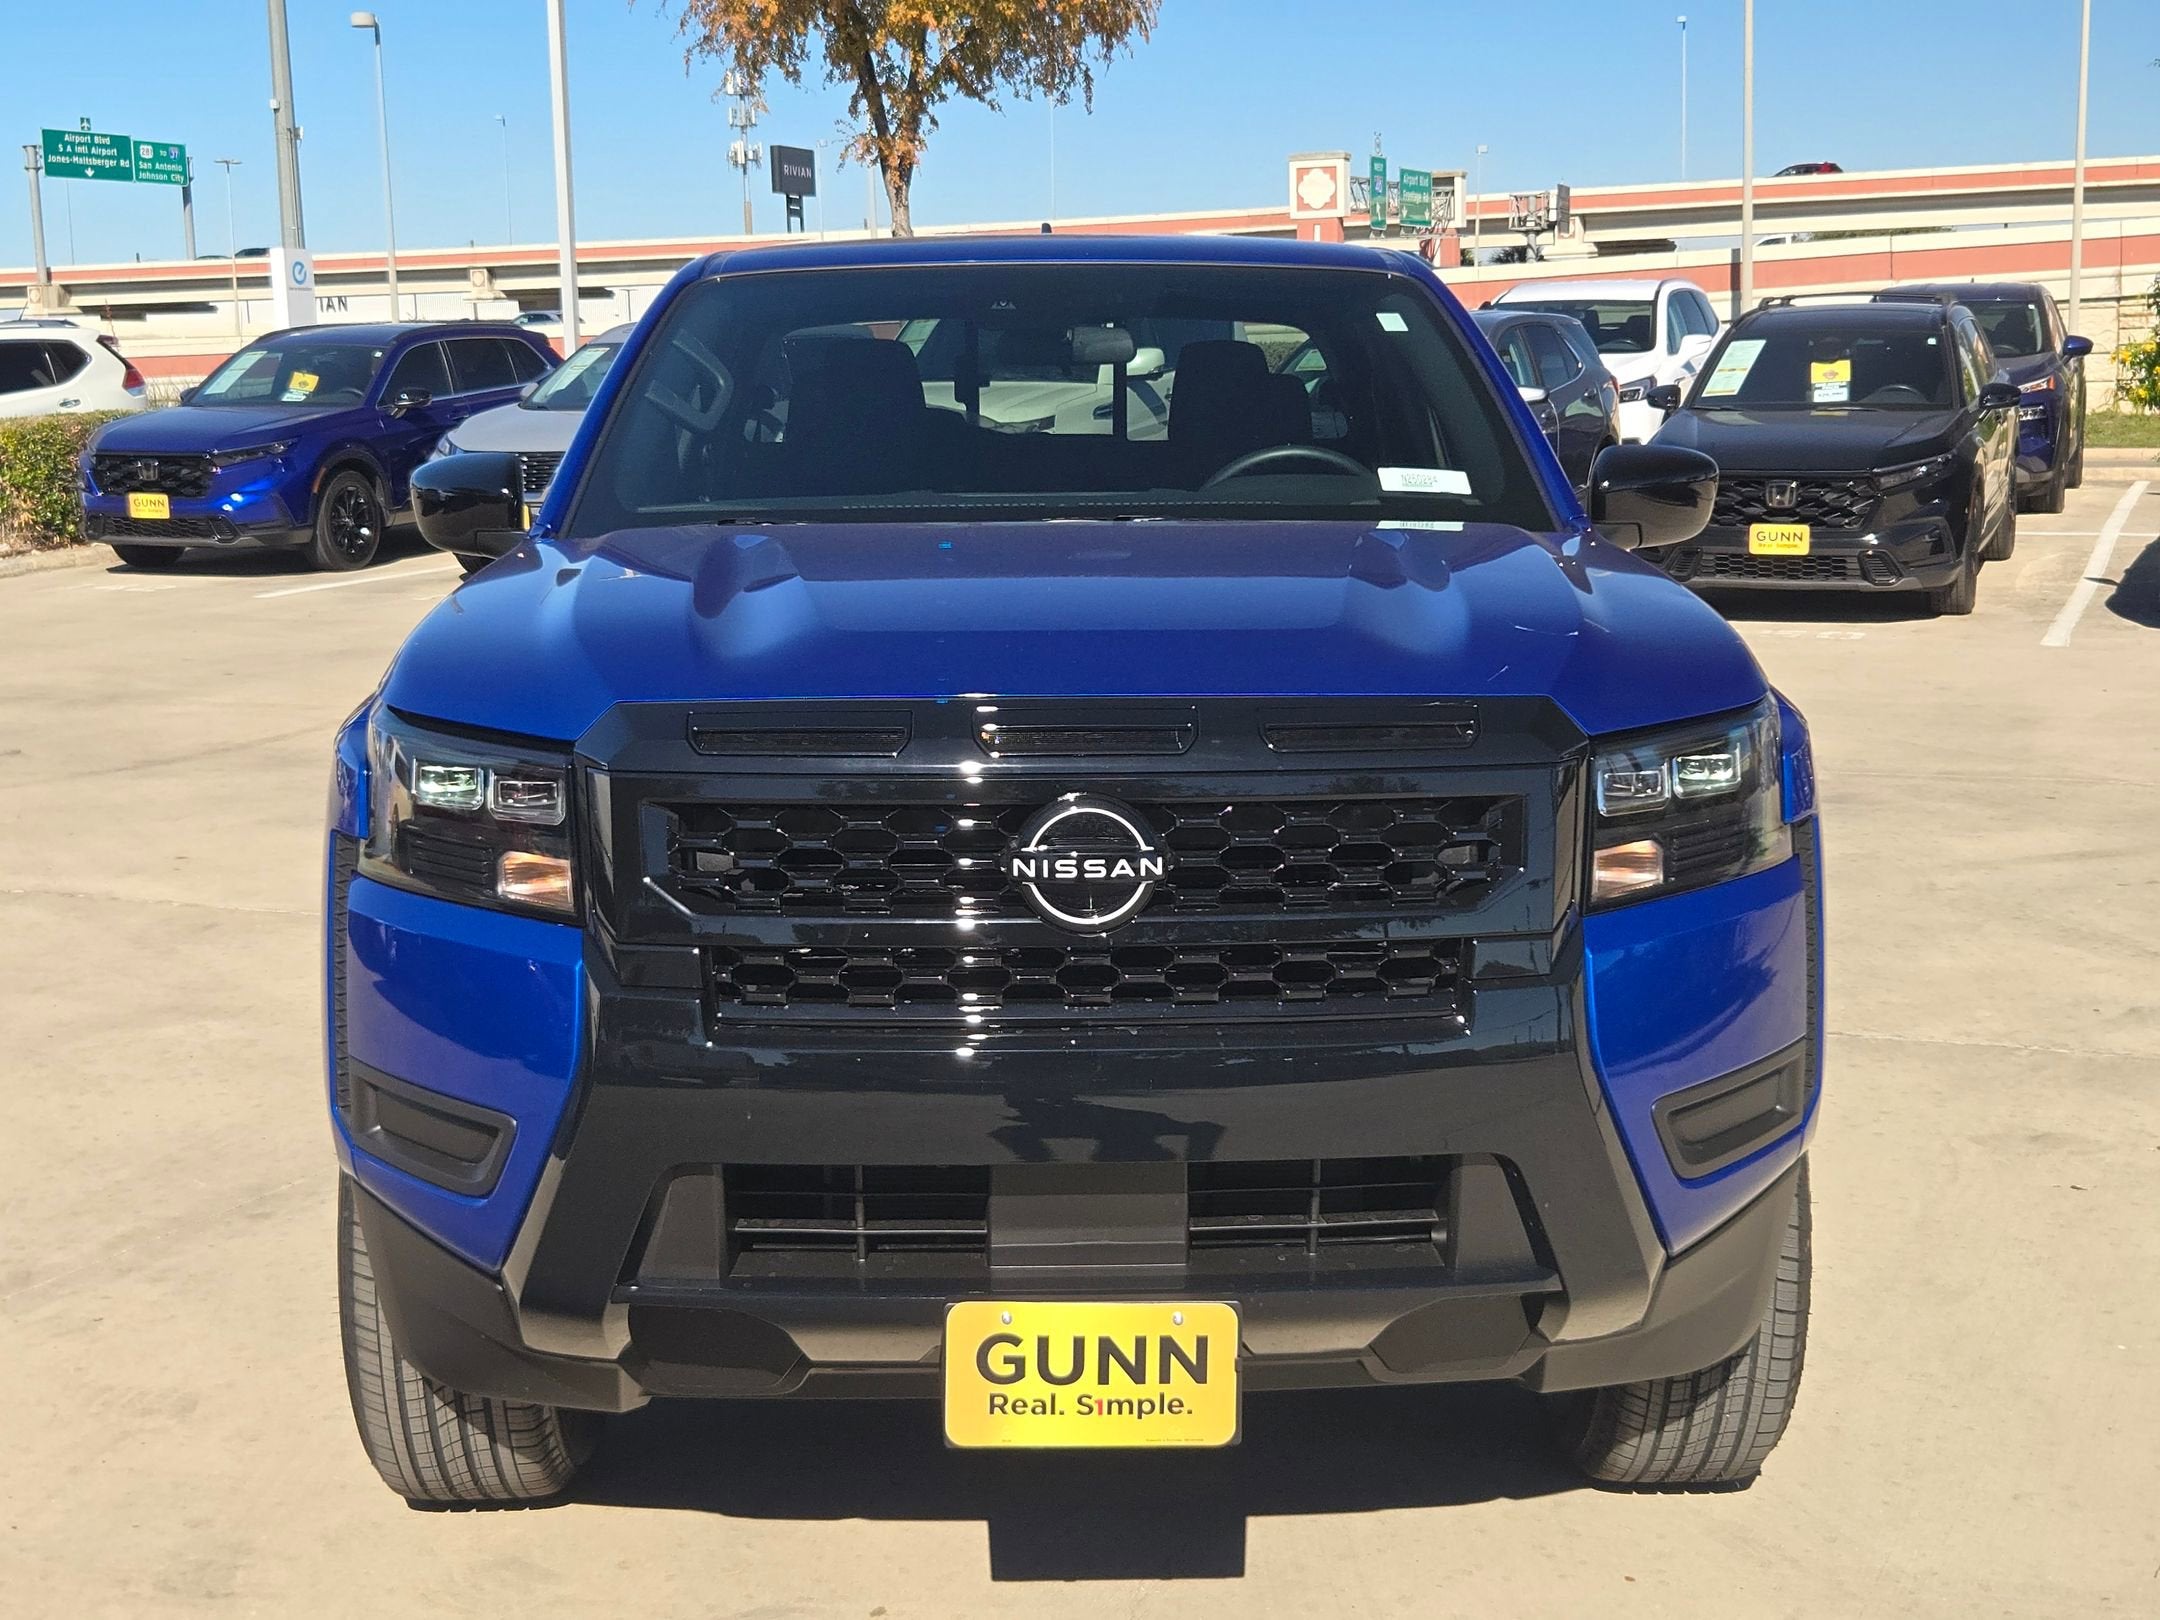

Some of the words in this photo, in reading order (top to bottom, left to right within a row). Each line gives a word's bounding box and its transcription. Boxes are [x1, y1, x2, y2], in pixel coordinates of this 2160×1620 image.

[64, 133, 91, 144] Airport
[94, 135, 111, 145] Blvd
[58, 144, 64, 153] S
[66, 144, 72, 153] A
[91, 146, 117, 157] Airport
[119, 159, 130, 168] Rd
[139, 161, 152, 170] San
[154, 162, 183, 172] Antonio
[138, 170, 168, 181] Johnson
[171, 173, 185, 185] City
[783, 164, 812, 179] RIVIAN
[133, 498, 165, 507] GUNN
[1756, 531, 1803, 542] GUNN
[1012, 857, 1163, 879] NISSAN
[976, 1333, 1209, 1385] GUNN
[989, 1393, 1065, 1416] Real.
